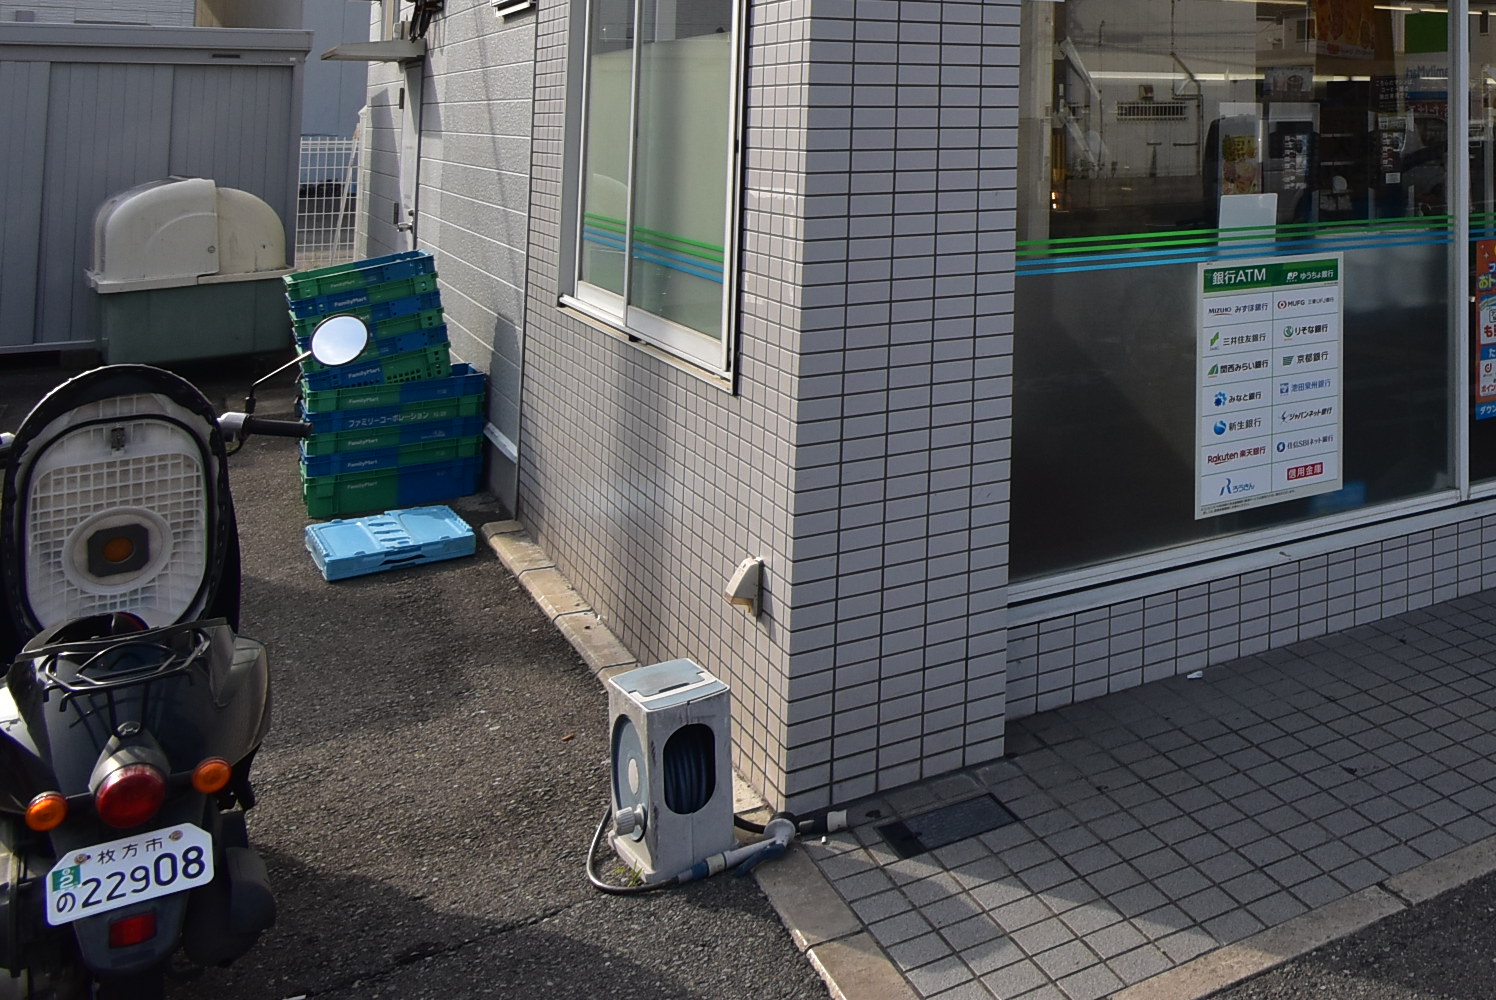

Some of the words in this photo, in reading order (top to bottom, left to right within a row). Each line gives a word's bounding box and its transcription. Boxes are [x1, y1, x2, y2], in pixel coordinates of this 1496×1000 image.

[1212, 268, 1267, 285] 銀行ATM
[1300, 269, 1334, 280] ゆうちょ銀行
[334, 296, 367, 308] FamilyMart
[1208, 306, 1232, 314] MIZUHO
[1234, 302, 1268, 313] みずほ銀行
[1287, 299, 1306, 307] MUFG
[1294, 323, 1329, 336] りそな銀行
[1223, 333, 1266, 346] 三井住友銀行
[1296, 351, 1329, 364] 京都銀行
[348, 366, 380, 379] FamilyMart
[1220, 360, 1269, 374] 関西みらい銀行
[1290, 378, 1332, 392] 池田泉州銀行
[1228, 391, 1262, 403] みなと銀行
[348, 411, 429, 428] ファミリーコーポレーション
[1288, 406, 1333, 421] ジャパンネット銀行
[1228, 418, 1262, 431] 新生銀行
[348, 437, 378, 446] FamilyMart
[1207, 450, 1239, 465] Rakuten
[1239, 446, 1267, 458] 楽天銀行
[347, 459, 378, 468] FamilyMart
[1288, 464, 1323, 480] 信用金庫
[347, 481, 378, 490] FamilyMart
[1232, 481, 1255, 494] ろうきん
[97, 837, 163, 865] 枚方市
[56, 892, 76, 913] の
[81, 845, 206, 909] 22908
